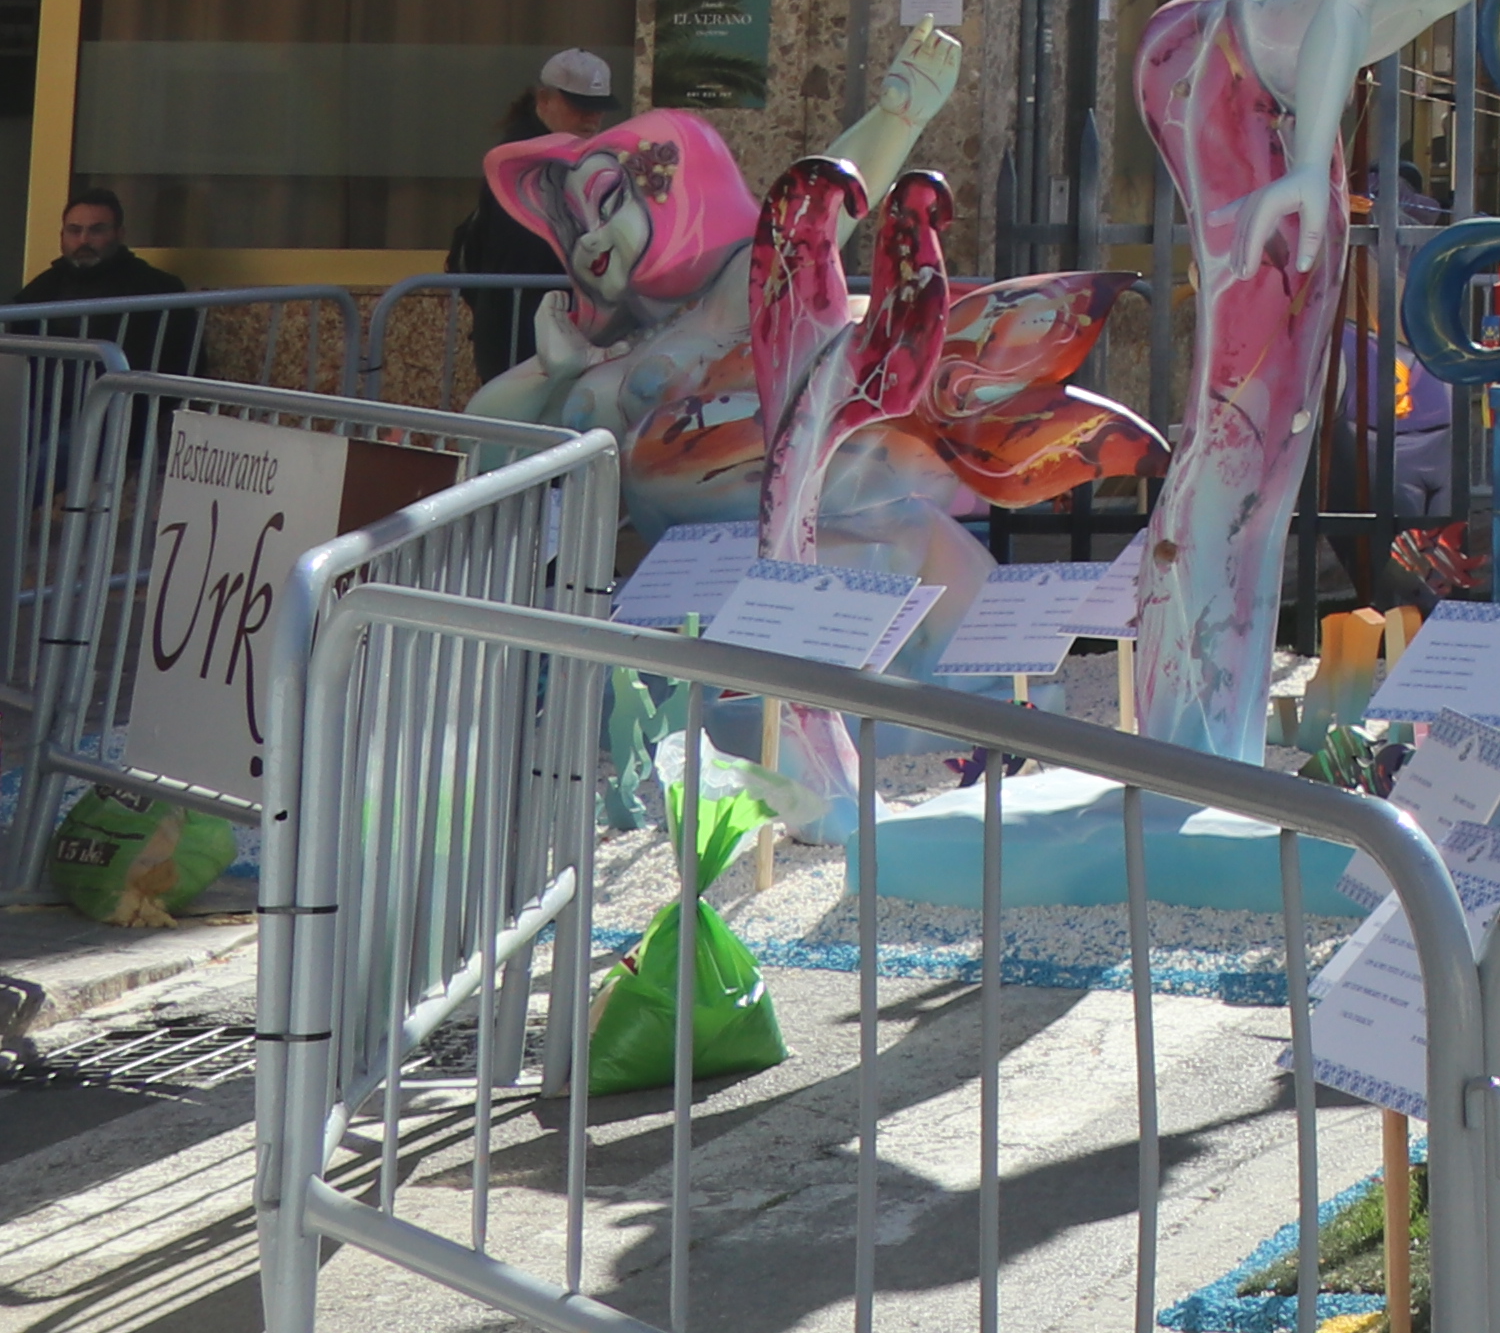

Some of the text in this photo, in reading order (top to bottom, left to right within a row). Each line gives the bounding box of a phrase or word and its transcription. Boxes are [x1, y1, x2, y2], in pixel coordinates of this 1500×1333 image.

[673, 13, 753, 26] EL VERANO
[169, 429, 280, 496] Restaurante
